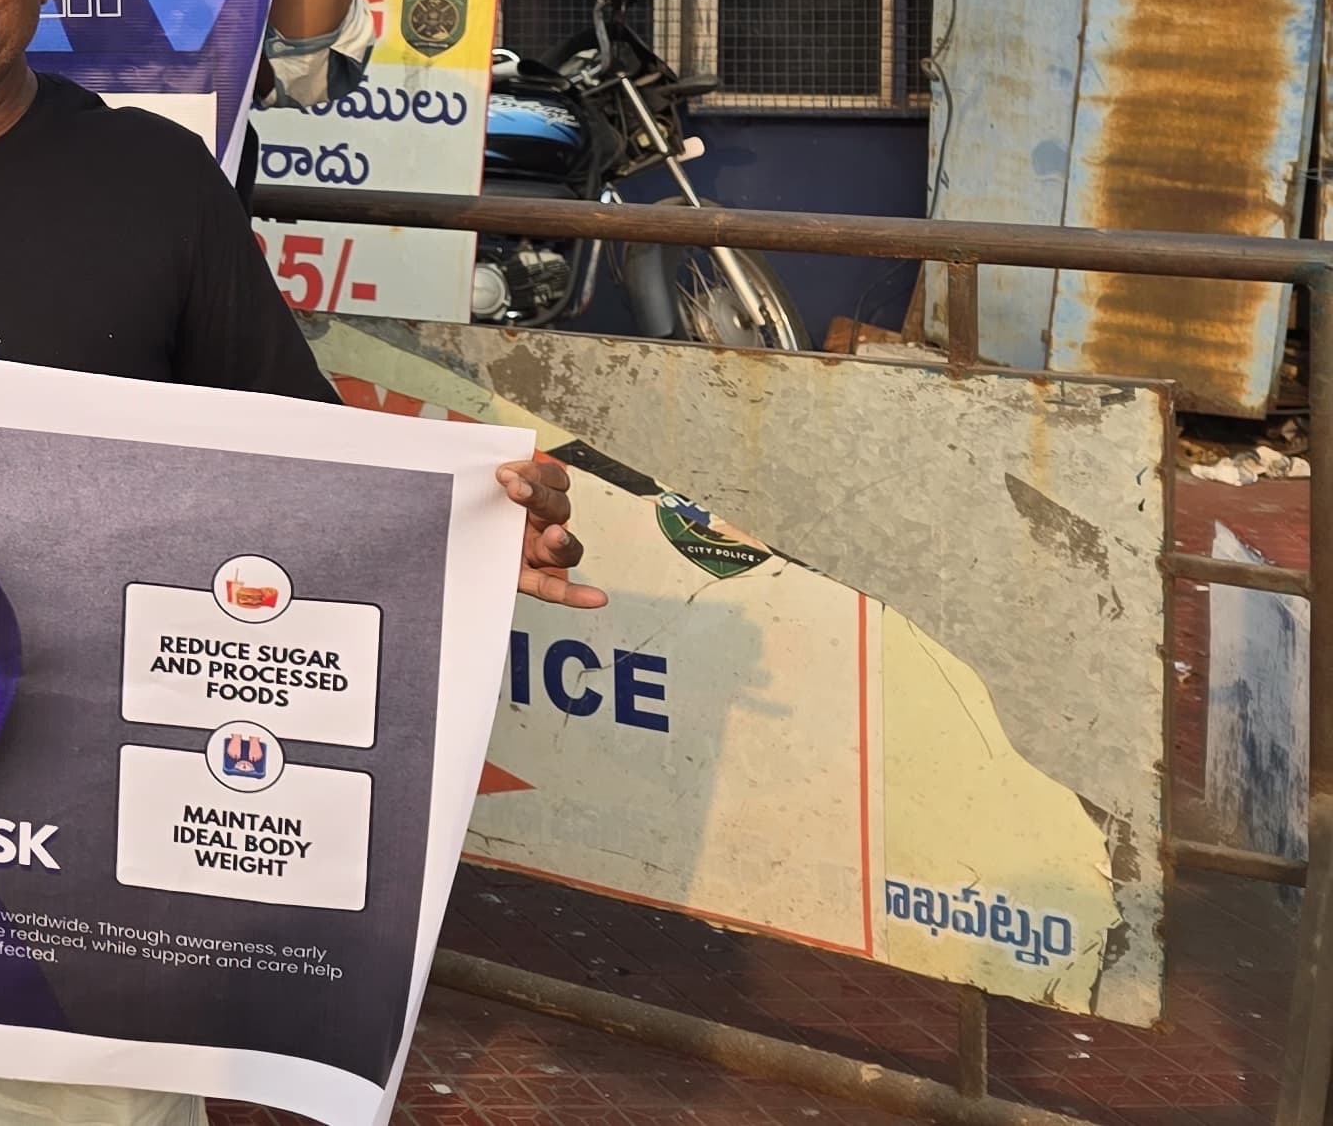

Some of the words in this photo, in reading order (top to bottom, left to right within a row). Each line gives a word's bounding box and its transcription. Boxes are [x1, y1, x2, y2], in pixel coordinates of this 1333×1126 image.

[261, 143, 370, 185] రాదు
[253, 233, 377, 313] 5/-
[687, 545, 712, 555] CITY
[715, 548, 755, 562] POLICE
[159, 635, 251, 661] REDUCE
[257, 645, 341, 671] SUGAR
[150, 656, 202, 675] AND
[208, 660, 349, 692] PROCESSED
[206, 681, 289, 707] FOODS
[183, 804, 302, 837] MAINTAIN
[173, 825, 238, 851] IDEAL
[244, 834, 313, 859] BODY
[194, 849, 288, 877] WEIGHT
[0, 908, 93, 935] worldwide.
[98, 921, 171, 947] Through
[175, 934, 277, 957] awareness,
[282, 943, 328, 963] early
[10, 926, 87, 951] reduced,
[91, 937, 137, 957] while
[141, 945, 211, 967] support
[215, 952, 252, 970] and
[256, 957, 298, 974] care
[303, 961, 343, 981] help
